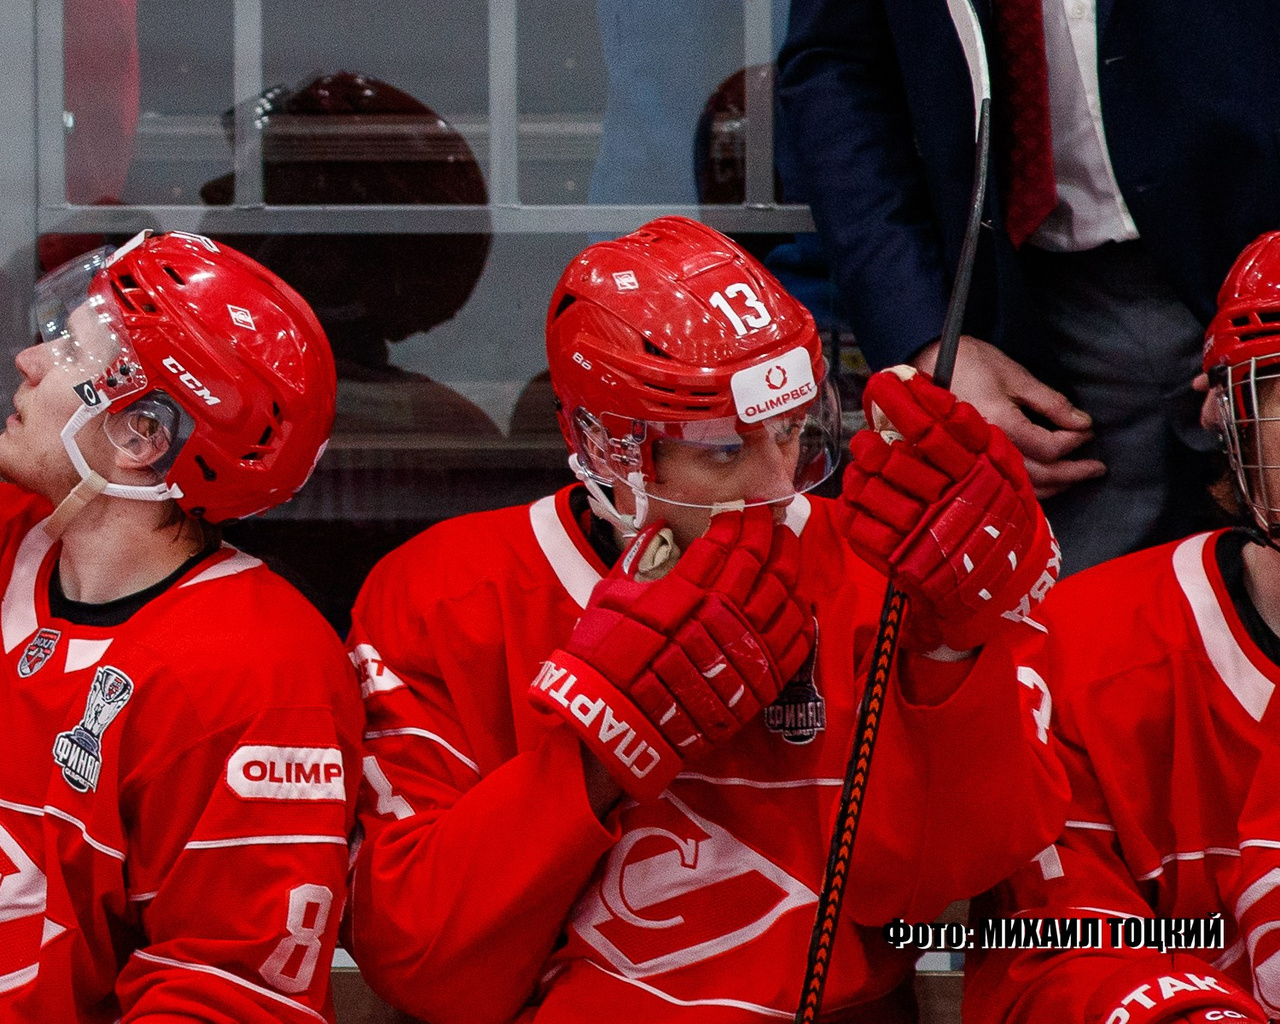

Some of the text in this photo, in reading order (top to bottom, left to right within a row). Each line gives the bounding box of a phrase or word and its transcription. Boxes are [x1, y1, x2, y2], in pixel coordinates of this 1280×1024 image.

[708, 282, 772, 337] 13
[162, 355, 221, 406] CCM
[744, 382, 813, 417] OLIMPBET
